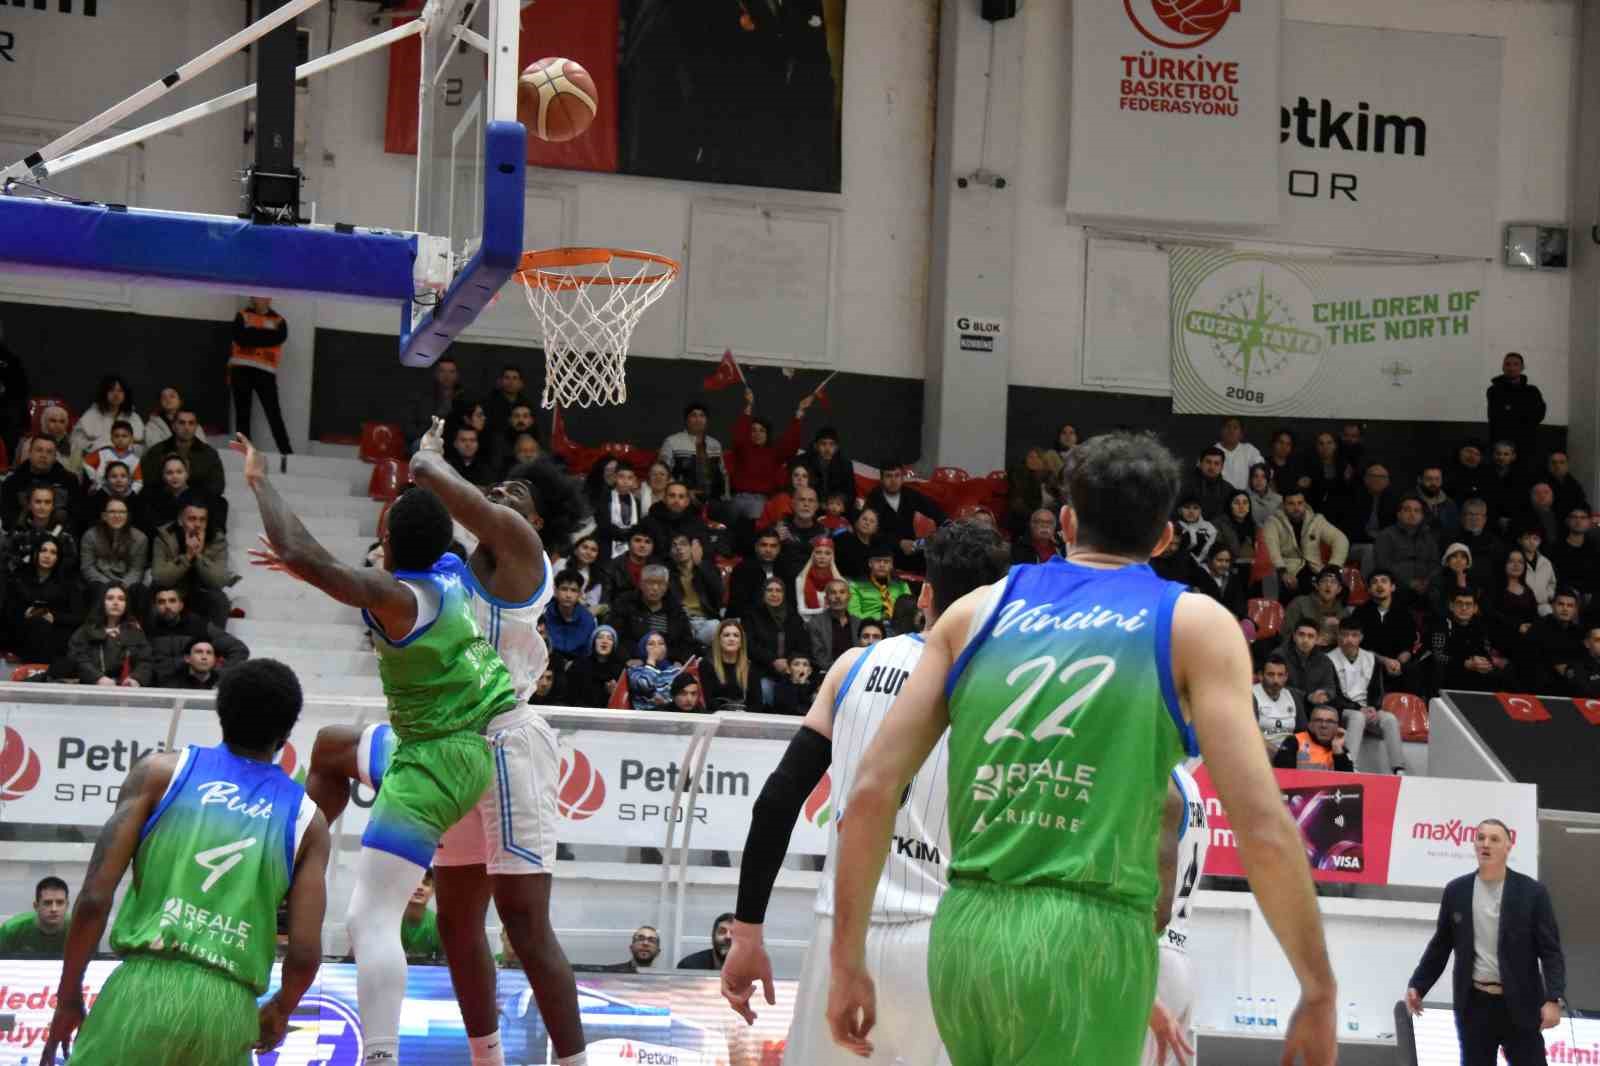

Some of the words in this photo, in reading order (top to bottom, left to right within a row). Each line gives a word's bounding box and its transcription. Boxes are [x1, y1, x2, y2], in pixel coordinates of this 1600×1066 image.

[1120, 50, 1239, 84] TÜRKİYE
[1120, 79, 1239, 102] BASKETBOL
[1119, 97, 1239, 117] FEDERASYONU
[1312, 294, 1440, 323] CHILDREN
[1448, 290, 1480, 312] OF
[957, 317, 970, 330] G
[1325, 320, 1376, 345] THE
[1383, 314, 1470, 341] NORTH
[1226, 386, 1265, 404] 2008
[992, 599, 1148, 638] Vincini
[984, 655, 1116, 745] 22
[57, 736, 166, 772] Petk
[1007, 758, 1097, 787] REALE
[1007, 780, 1089, 804] MTUA
[618, 803, 708, 824] SPOR
[195, 837, 257, 893] 4
[1332, 855, 1360, 868] VISA
[184, 902, 251, 937] REALE
